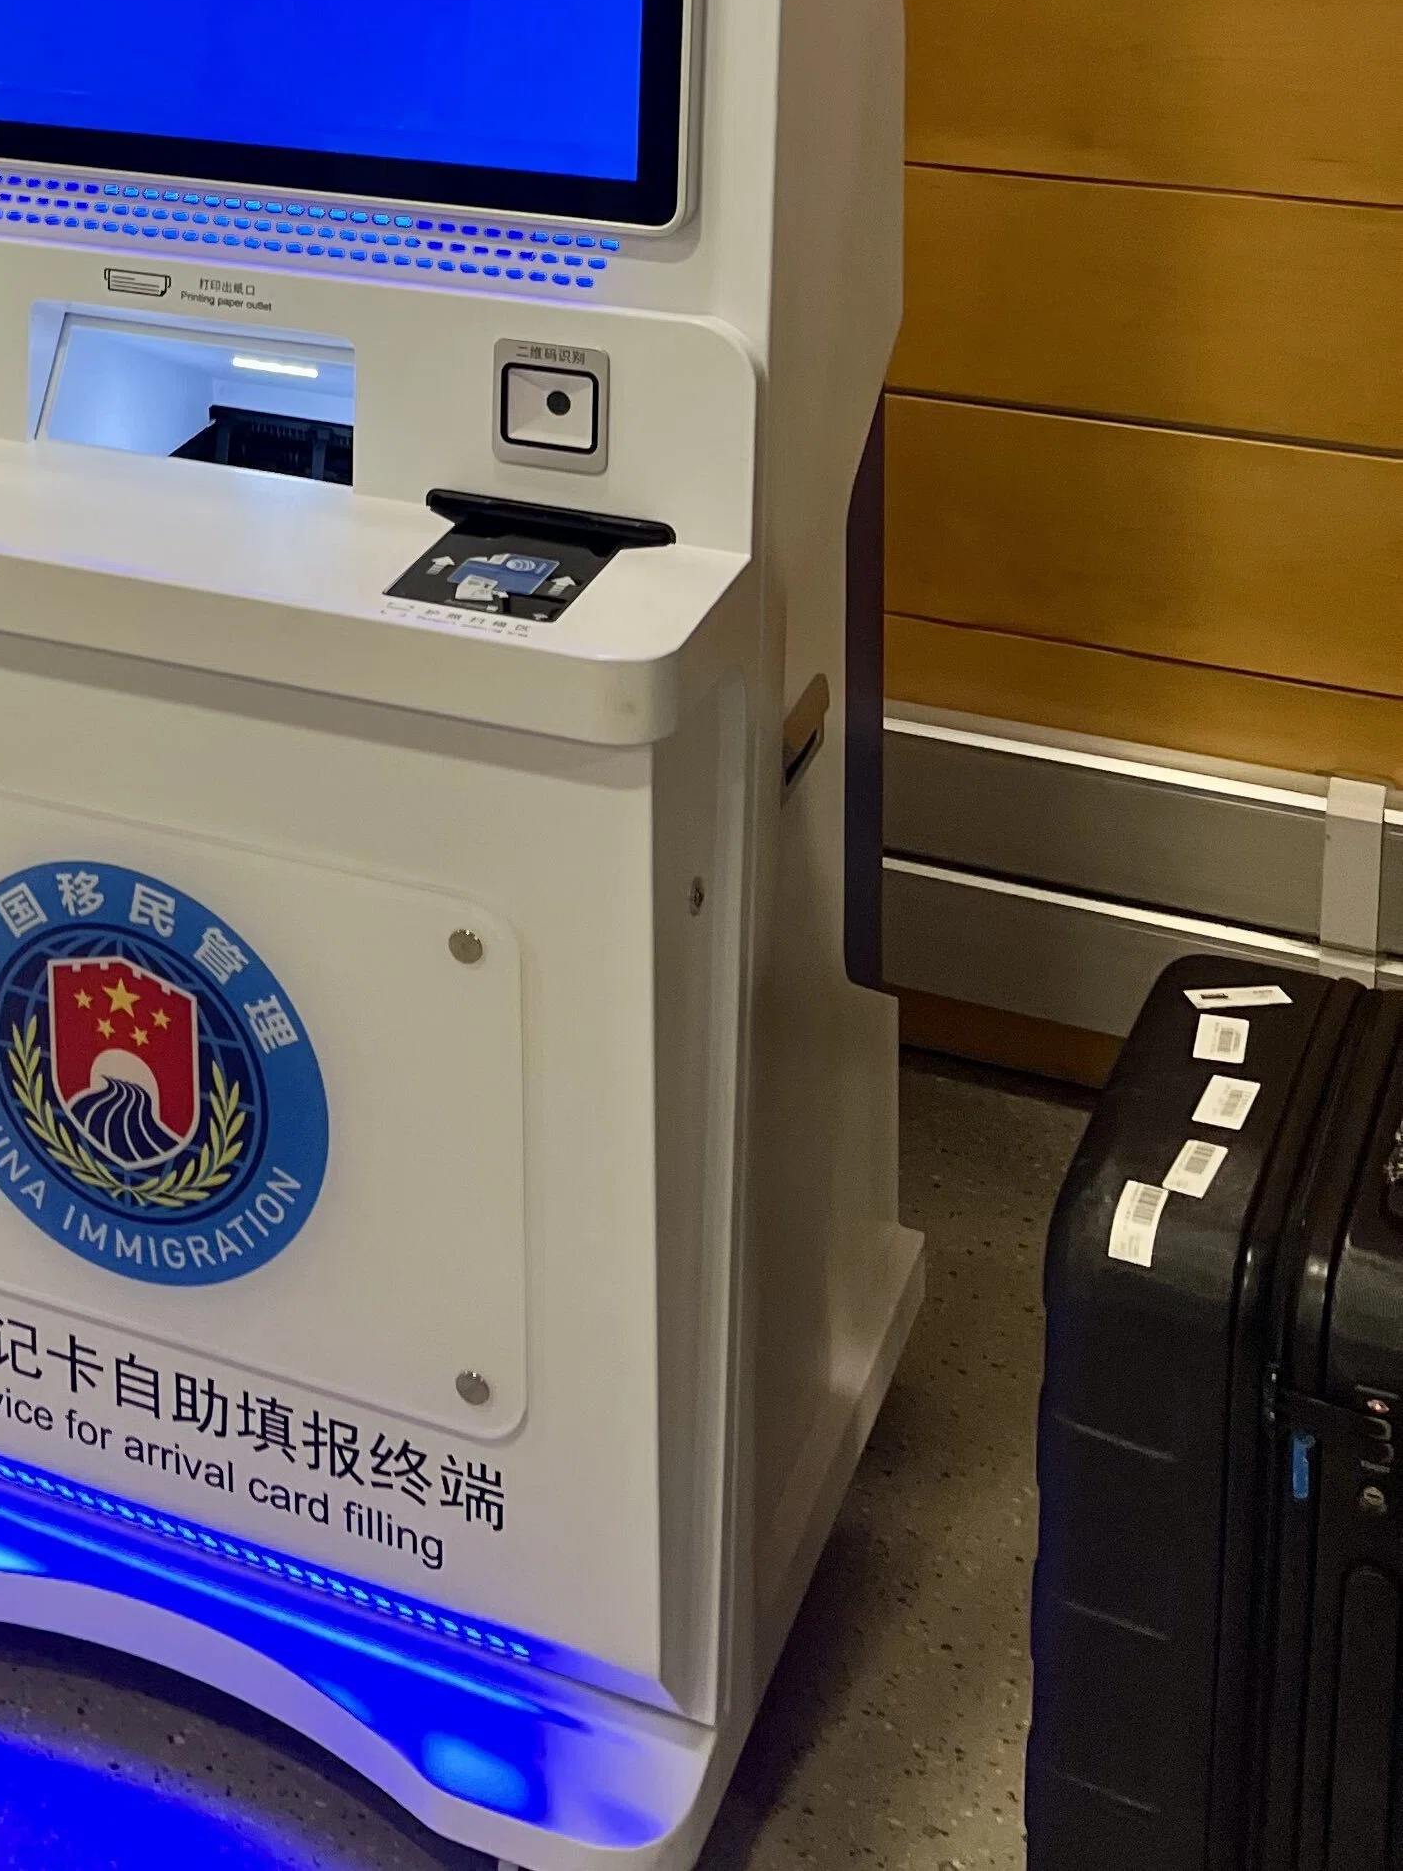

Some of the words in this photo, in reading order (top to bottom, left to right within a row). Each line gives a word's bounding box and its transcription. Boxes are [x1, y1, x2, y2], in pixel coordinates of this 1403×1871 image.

[180, 290, 215, 306] Printing
[217, 297, 244, 308] paper
[246, 300, 272, 311] outlet
[515, 344, 586, 366] 二维码识别
[62, 1166, 303, 1270] IMMIGRATION
[66, 1408, 114, 1452] for
[123, 1432, 236, 1496] arrival
[248, 1474, 330, 1526] card
[343, 1502, 446, 1571] filling
